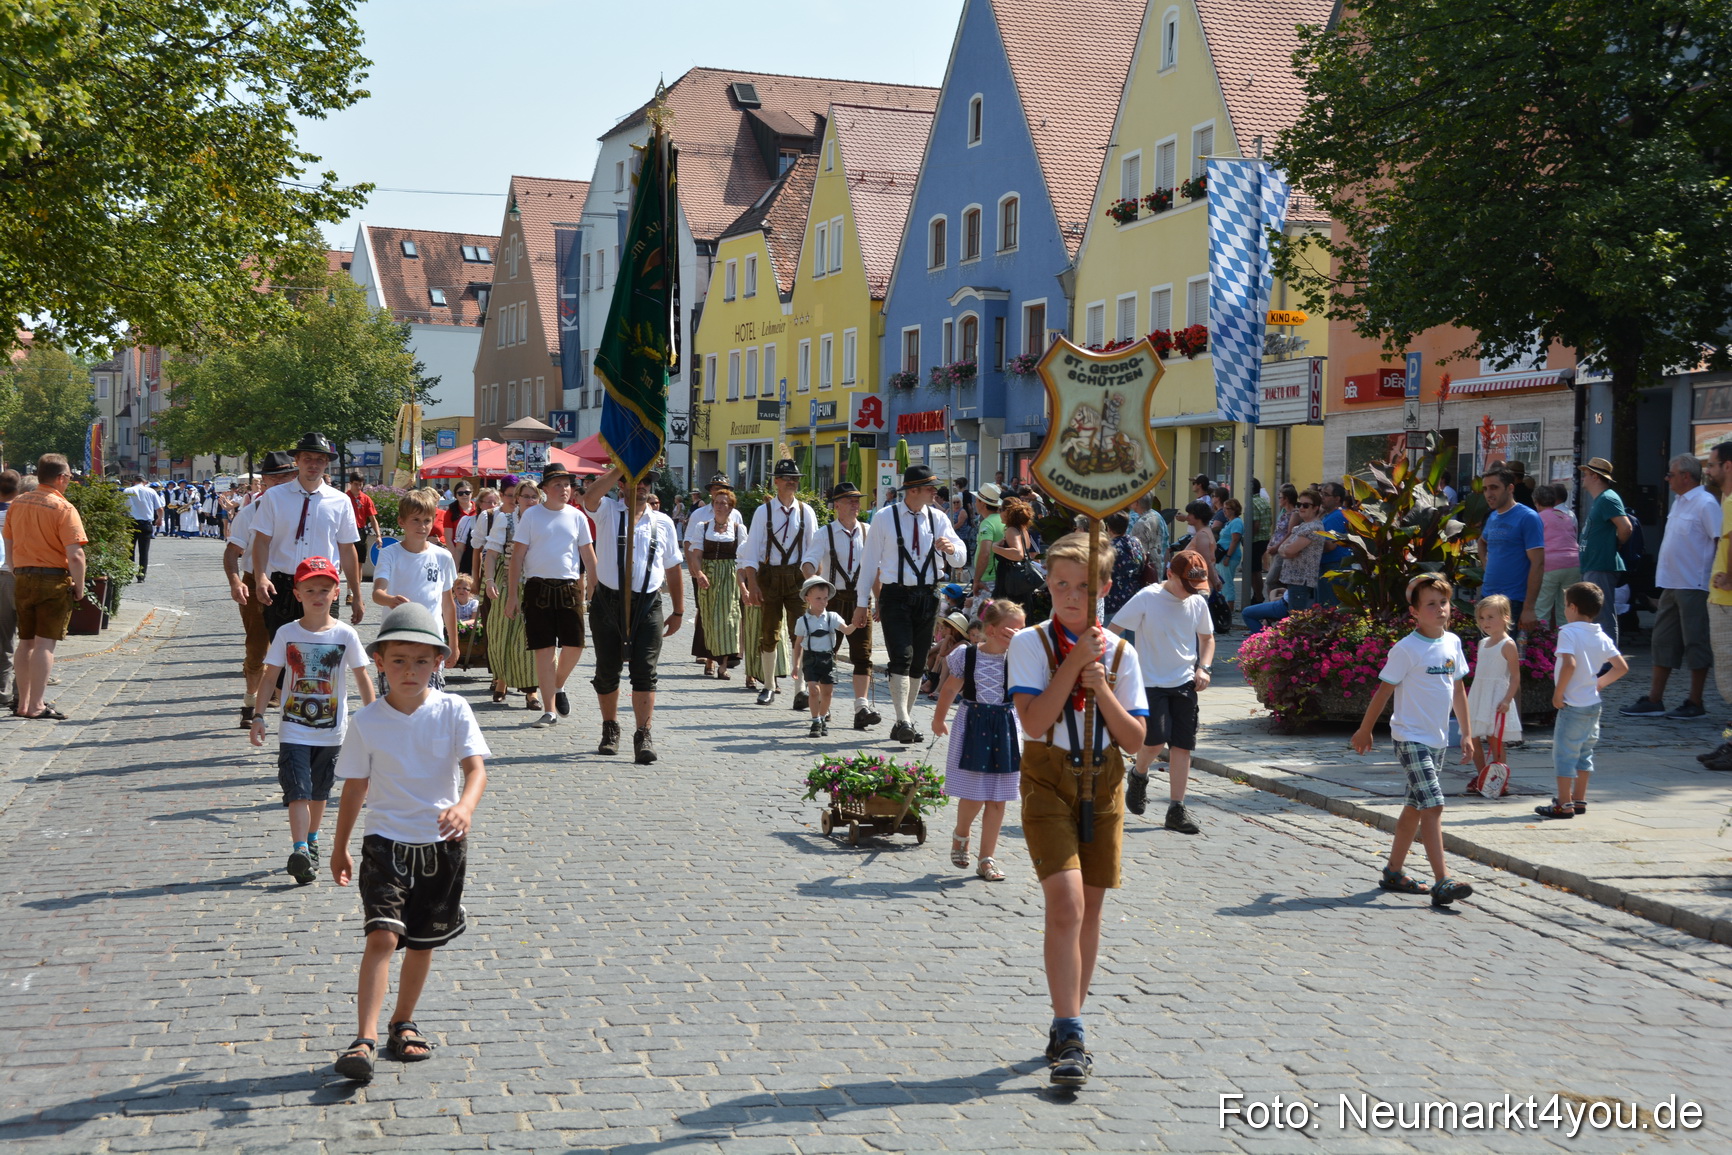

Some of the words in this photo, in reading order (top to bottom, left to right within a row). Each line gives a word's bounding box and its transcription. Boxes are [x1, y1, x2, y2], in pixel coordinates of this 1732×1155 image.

[1270, 312, 1290, 323] KINO
[1291, 315, 1305, 323] 40m
[735, 321, 757, 343] HOTEL
[761, 318, 786, 337] Lehmeier
[1063, 354, 1085, 372] ST.
[1089, 356, 1144, 375] GEORG-
[1408, 357, 1418, 391] P
[1067, 367, 1143, 387] SCHÜTZEN
[780, 382, 786, 403] P
[1286, 384, 1300, 398] KINO
[1311, 360, 1321, 419] KINO
[1345, 385, 1358, 399] DER
[810, 403, 816, 424] P
[816, 403, 831, 417] IFUN
[1594, 412, 1603, 425] 16
[730, 421, 761, 436] Restaurant
[1047, 468, 1128, 501] LODERBACH
[1130, 469, 1153, 489] e.V.
[427, 568, 438, 583] 83
